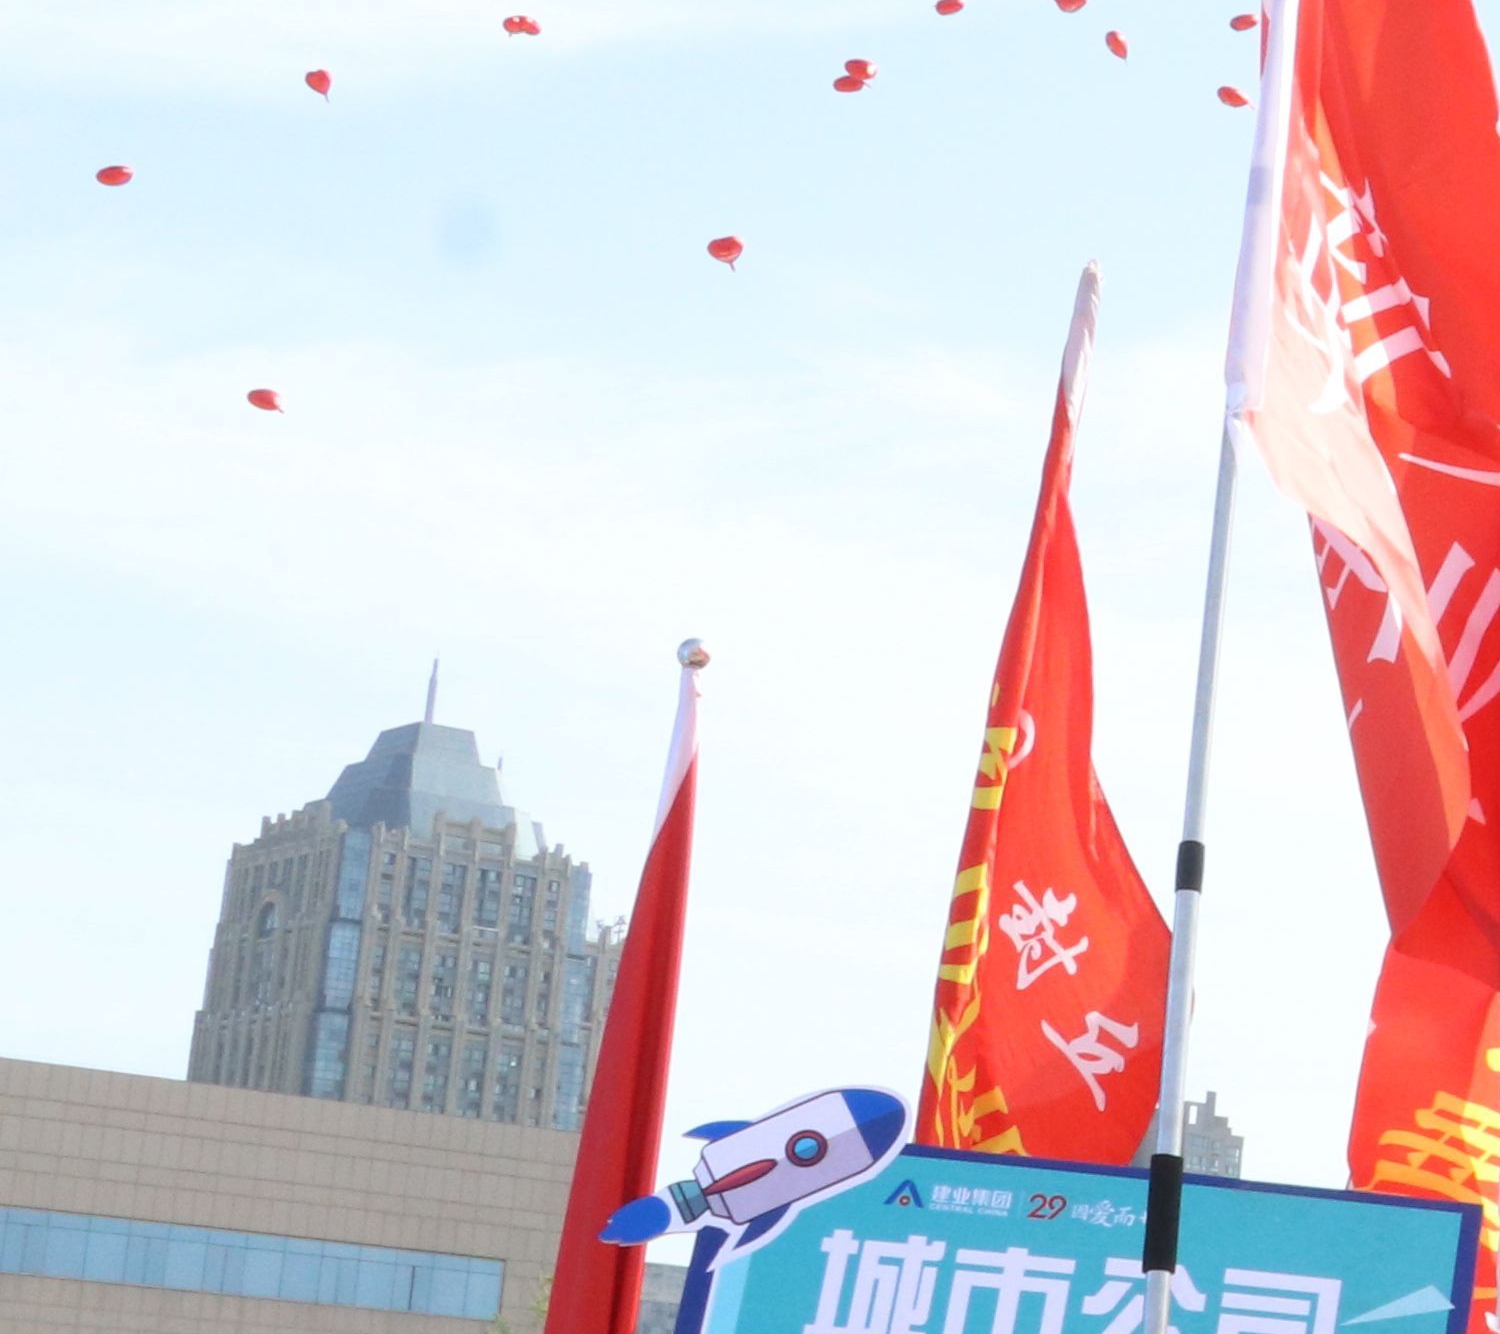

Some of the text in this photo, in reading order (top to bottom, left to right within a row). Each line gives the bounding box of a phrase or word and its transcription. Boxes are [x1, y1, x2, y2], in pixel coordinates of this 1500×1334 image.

[930, 1183, 1013, 1211] 建业集团
[1026, 1193, 1068, 1221] 29
[976, 1207, 1008, 1218] CHINA
